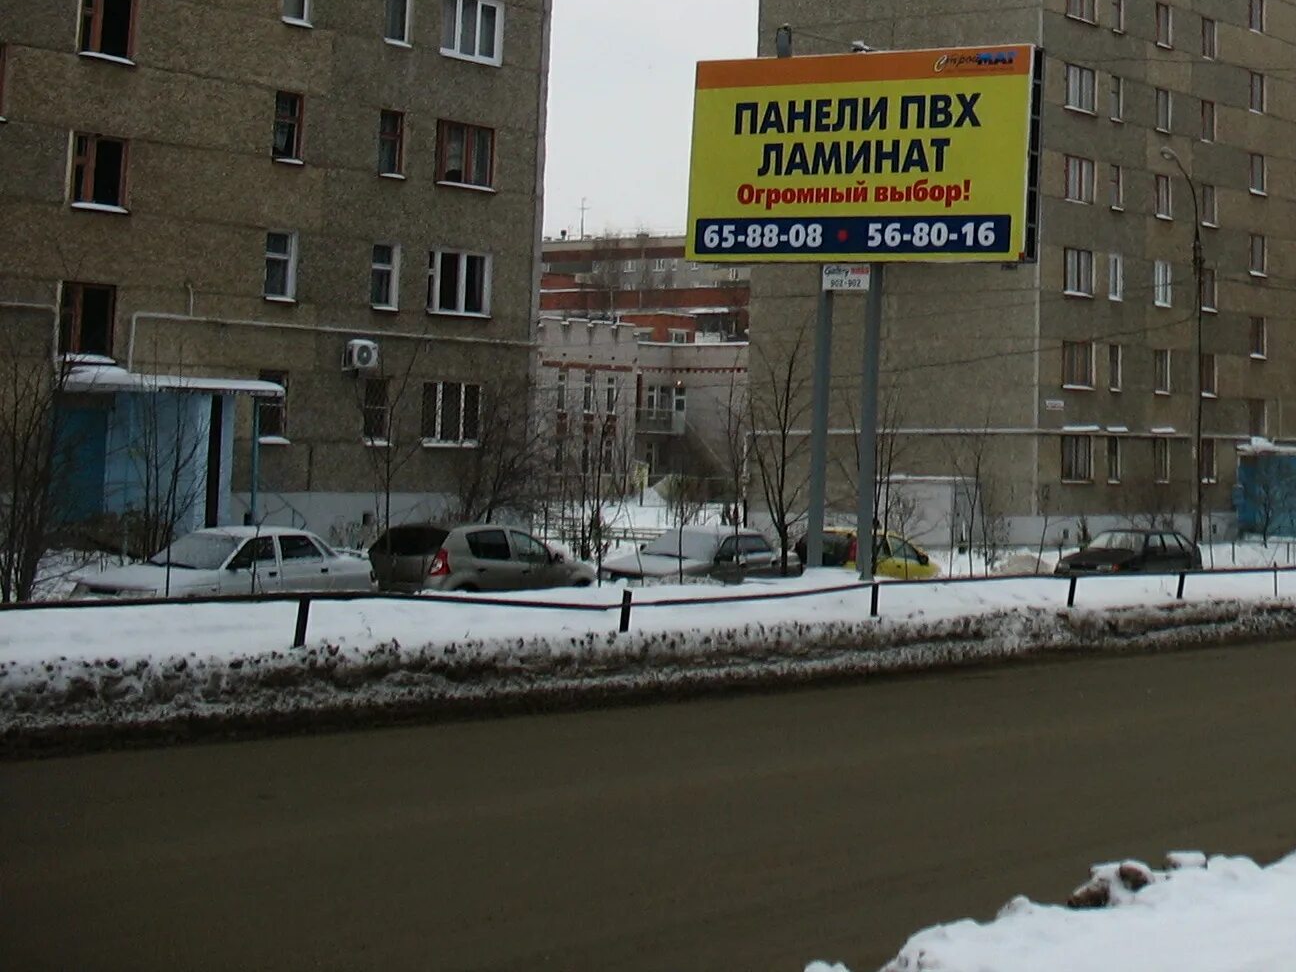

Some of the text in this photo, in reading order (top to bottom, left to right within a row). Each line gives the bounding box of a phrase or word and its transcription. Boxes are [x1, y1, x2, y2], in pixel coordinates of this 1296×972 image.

[734, 93, 981, 135] ПАНЕЛИ ПВХ
[757, 138, 950, 177] ЛАМИНАТ
[737, 180, 971, 210] Огромный выбор!
[703, 221, 996, 248] 65-88-08 56-80-16
